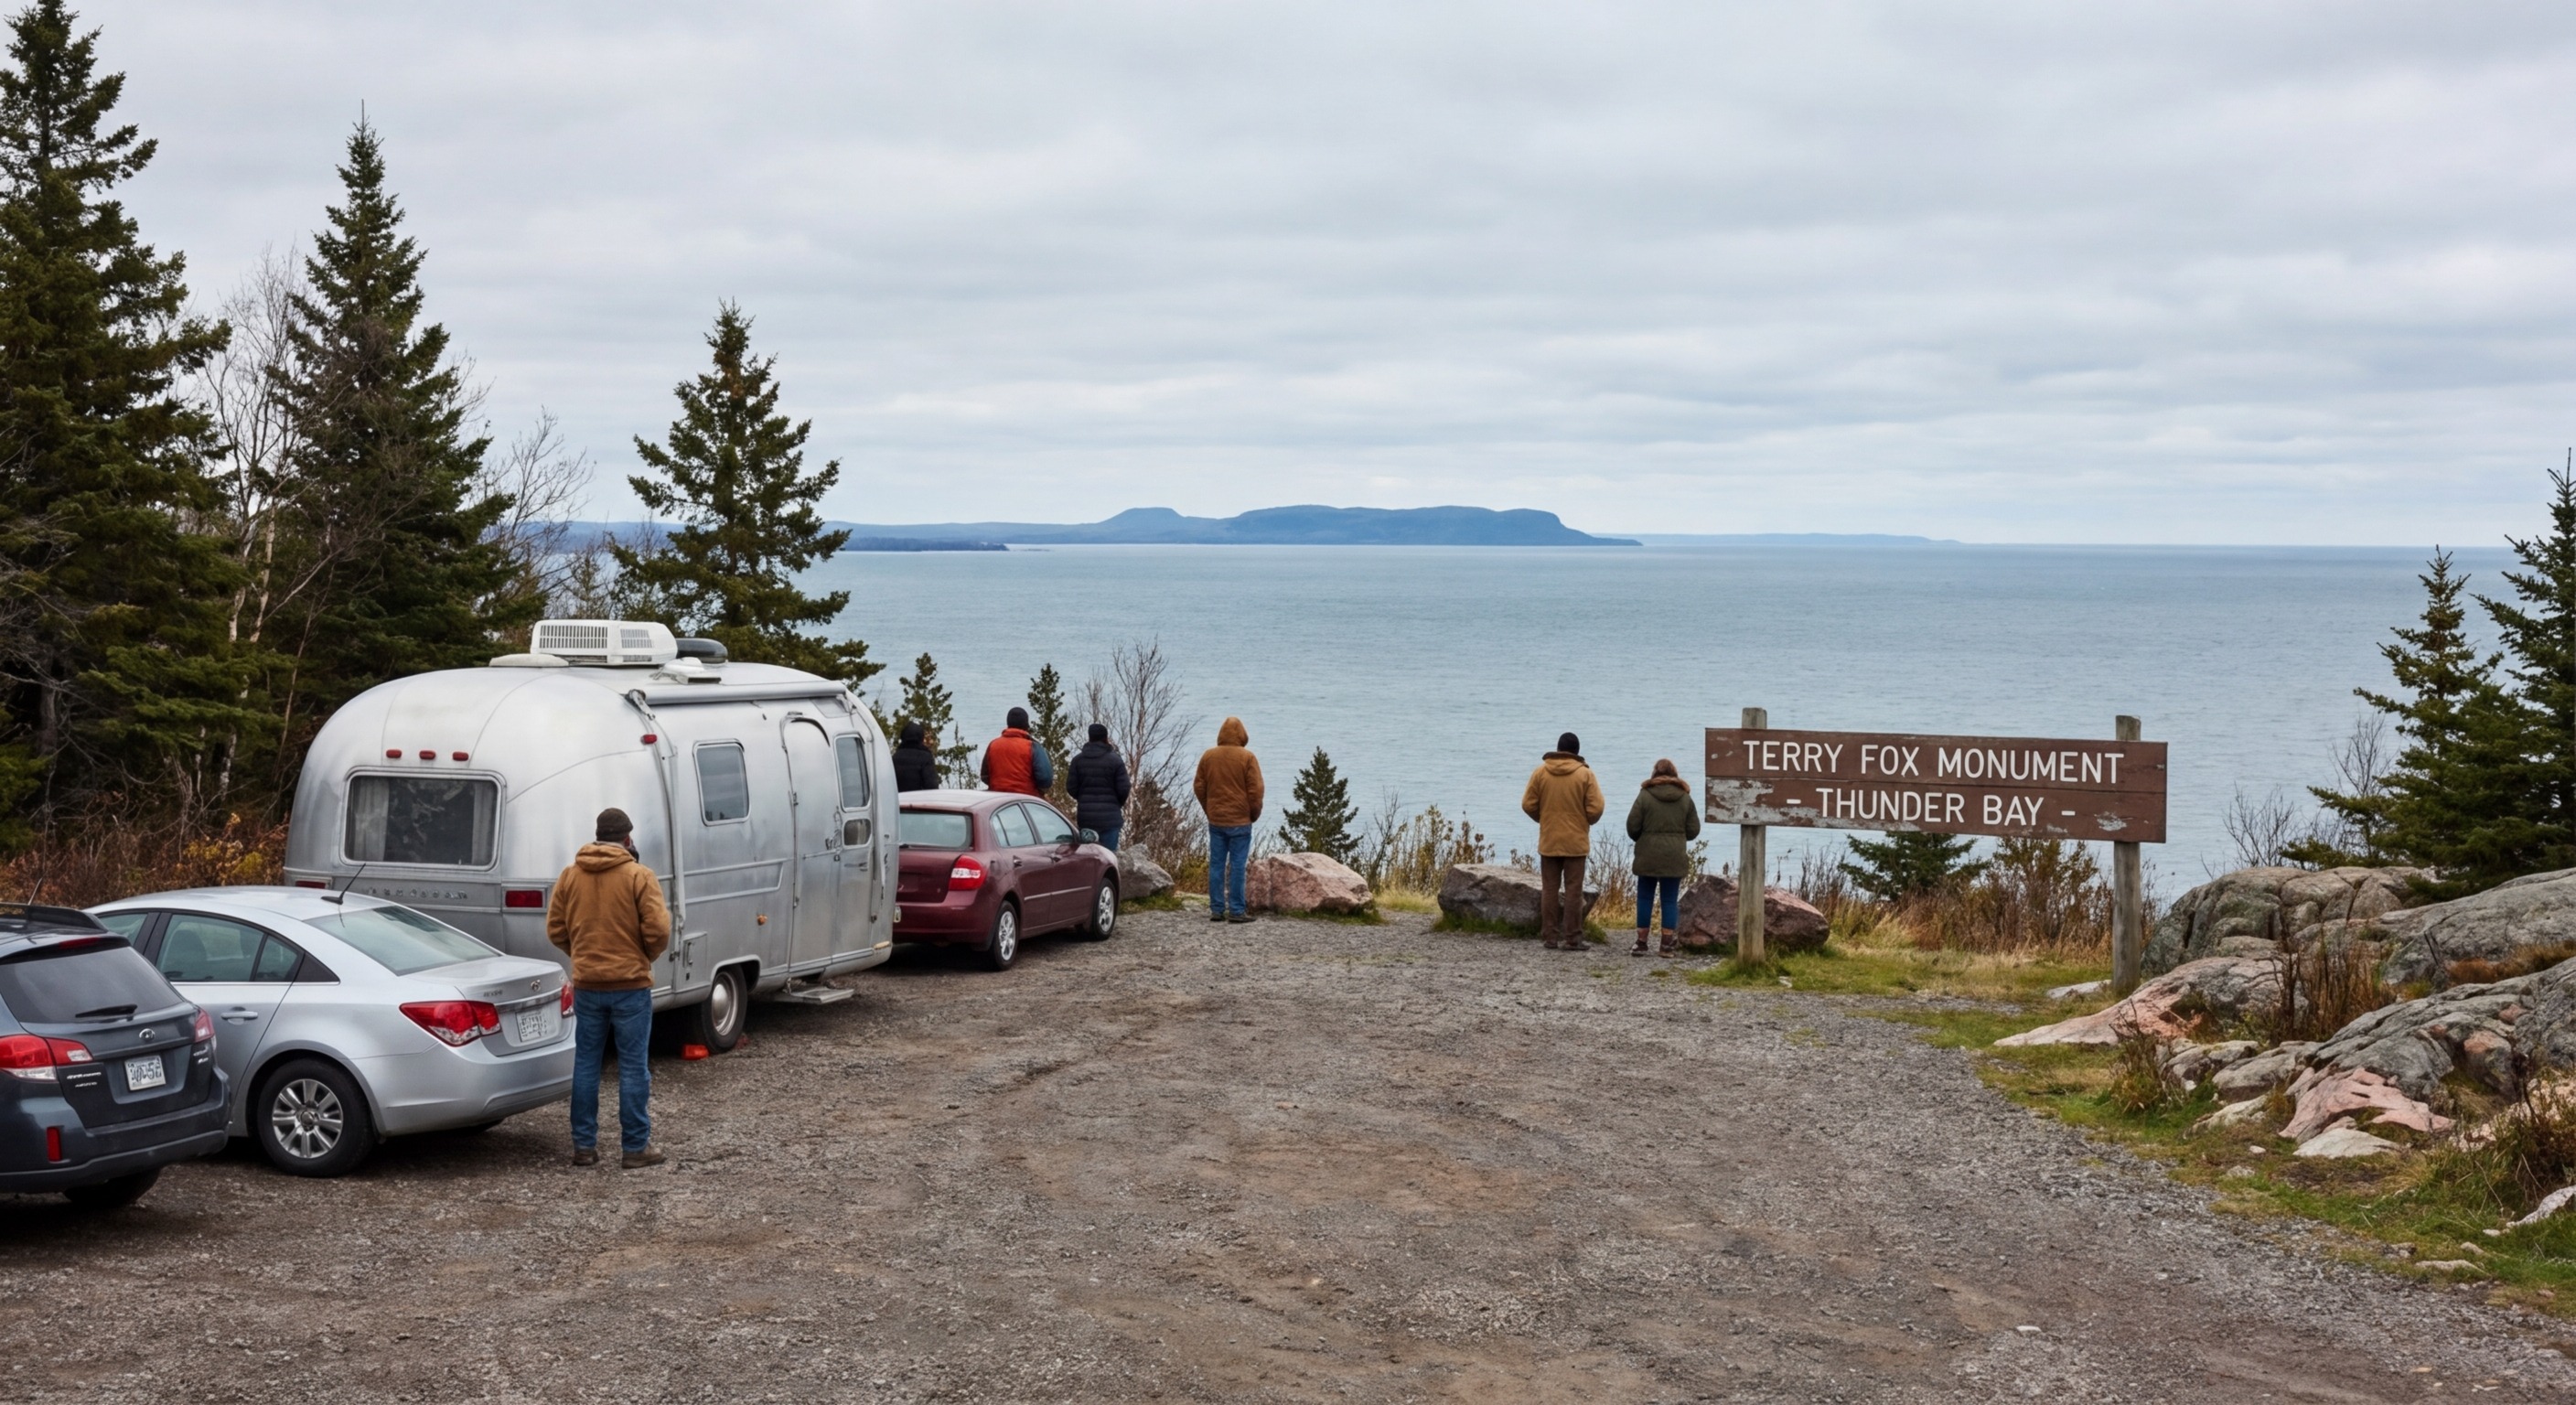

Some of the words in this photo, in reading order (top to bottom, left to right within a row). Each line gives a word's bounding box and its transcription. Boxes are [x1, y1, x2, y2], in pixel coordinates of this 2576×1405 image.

[1743, 740, 1843, 774] TERRY
[1861, 744, 1920, 778] FOX
[1937, 746, 2124, 784] MONUMENT
[1815, 788, 1965, 823] THUNDER
[1982, 794, 2045, 826] BAY
